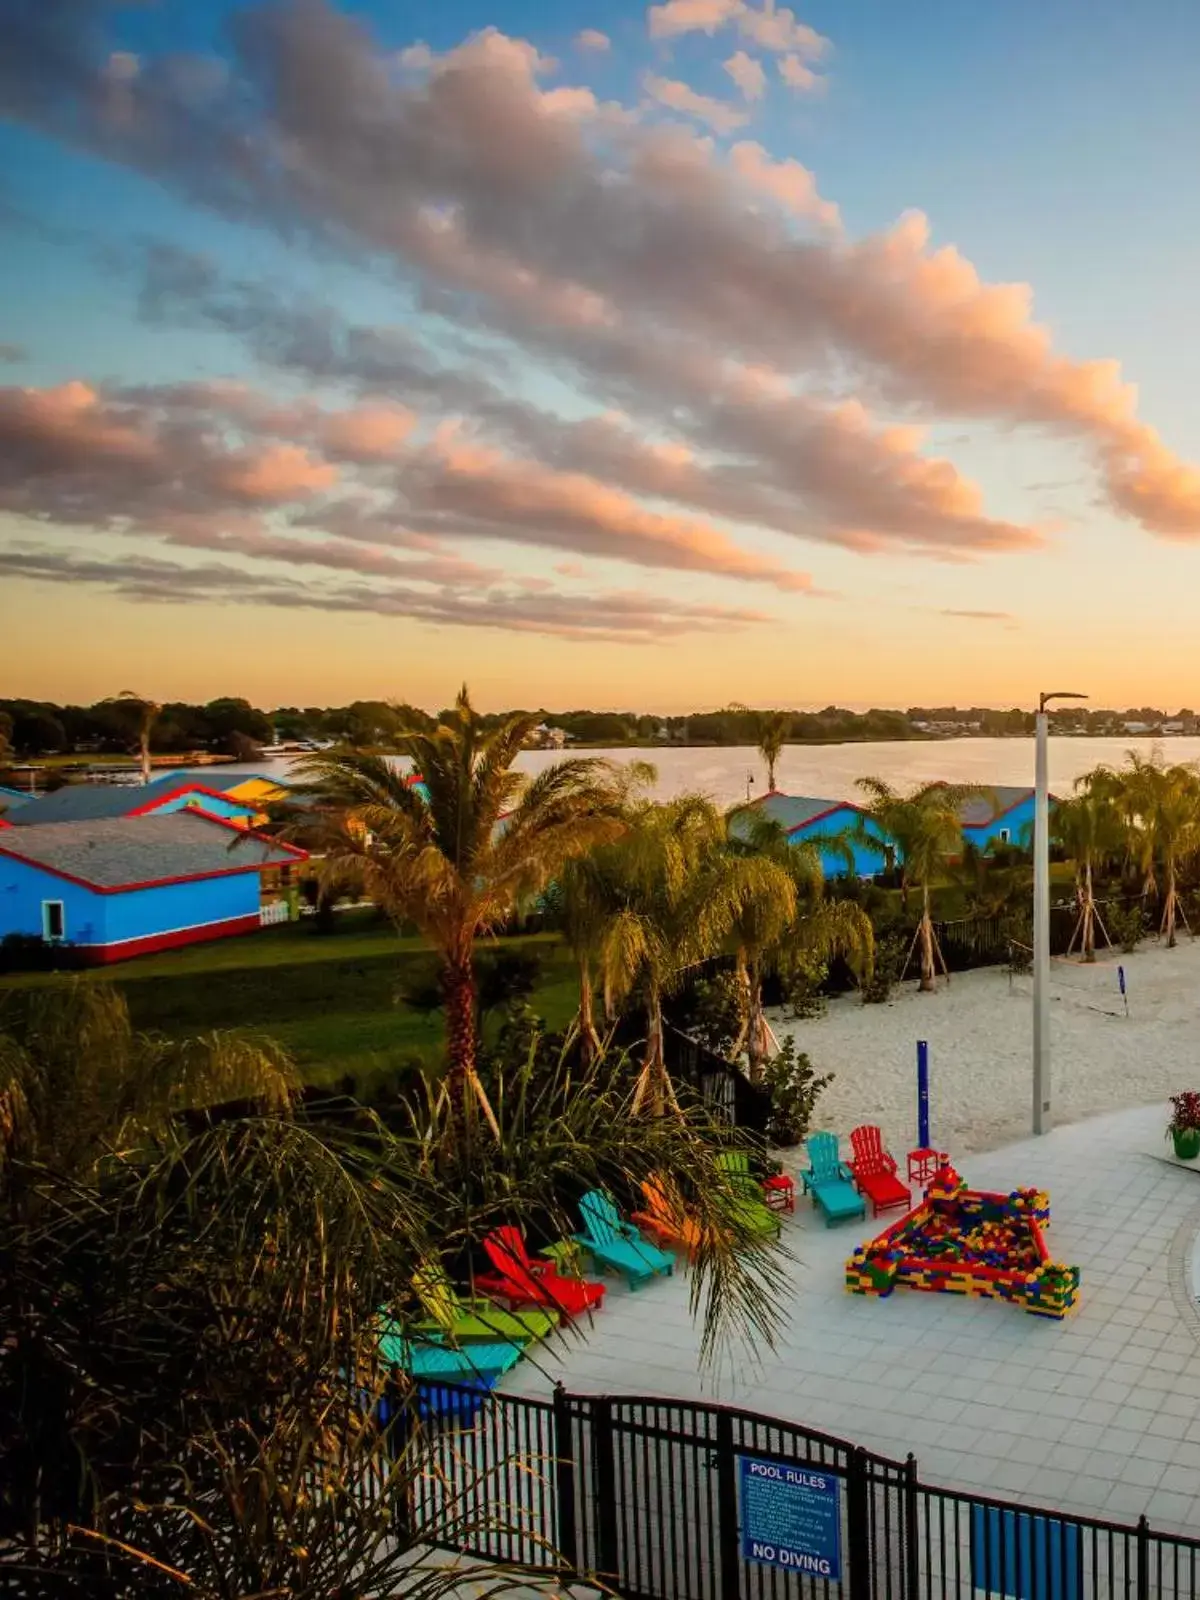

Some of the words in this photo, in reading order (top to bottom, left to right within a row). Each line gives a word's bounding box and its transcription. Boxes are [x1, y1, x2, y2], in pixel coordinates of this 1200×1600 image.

[750, 1463, 783, 1480] POOL
[786, 1470, 827, 1489] RULES
[752, 1542, 776, 1561] NO
[779, 1549, 832, 1575] DIVING
